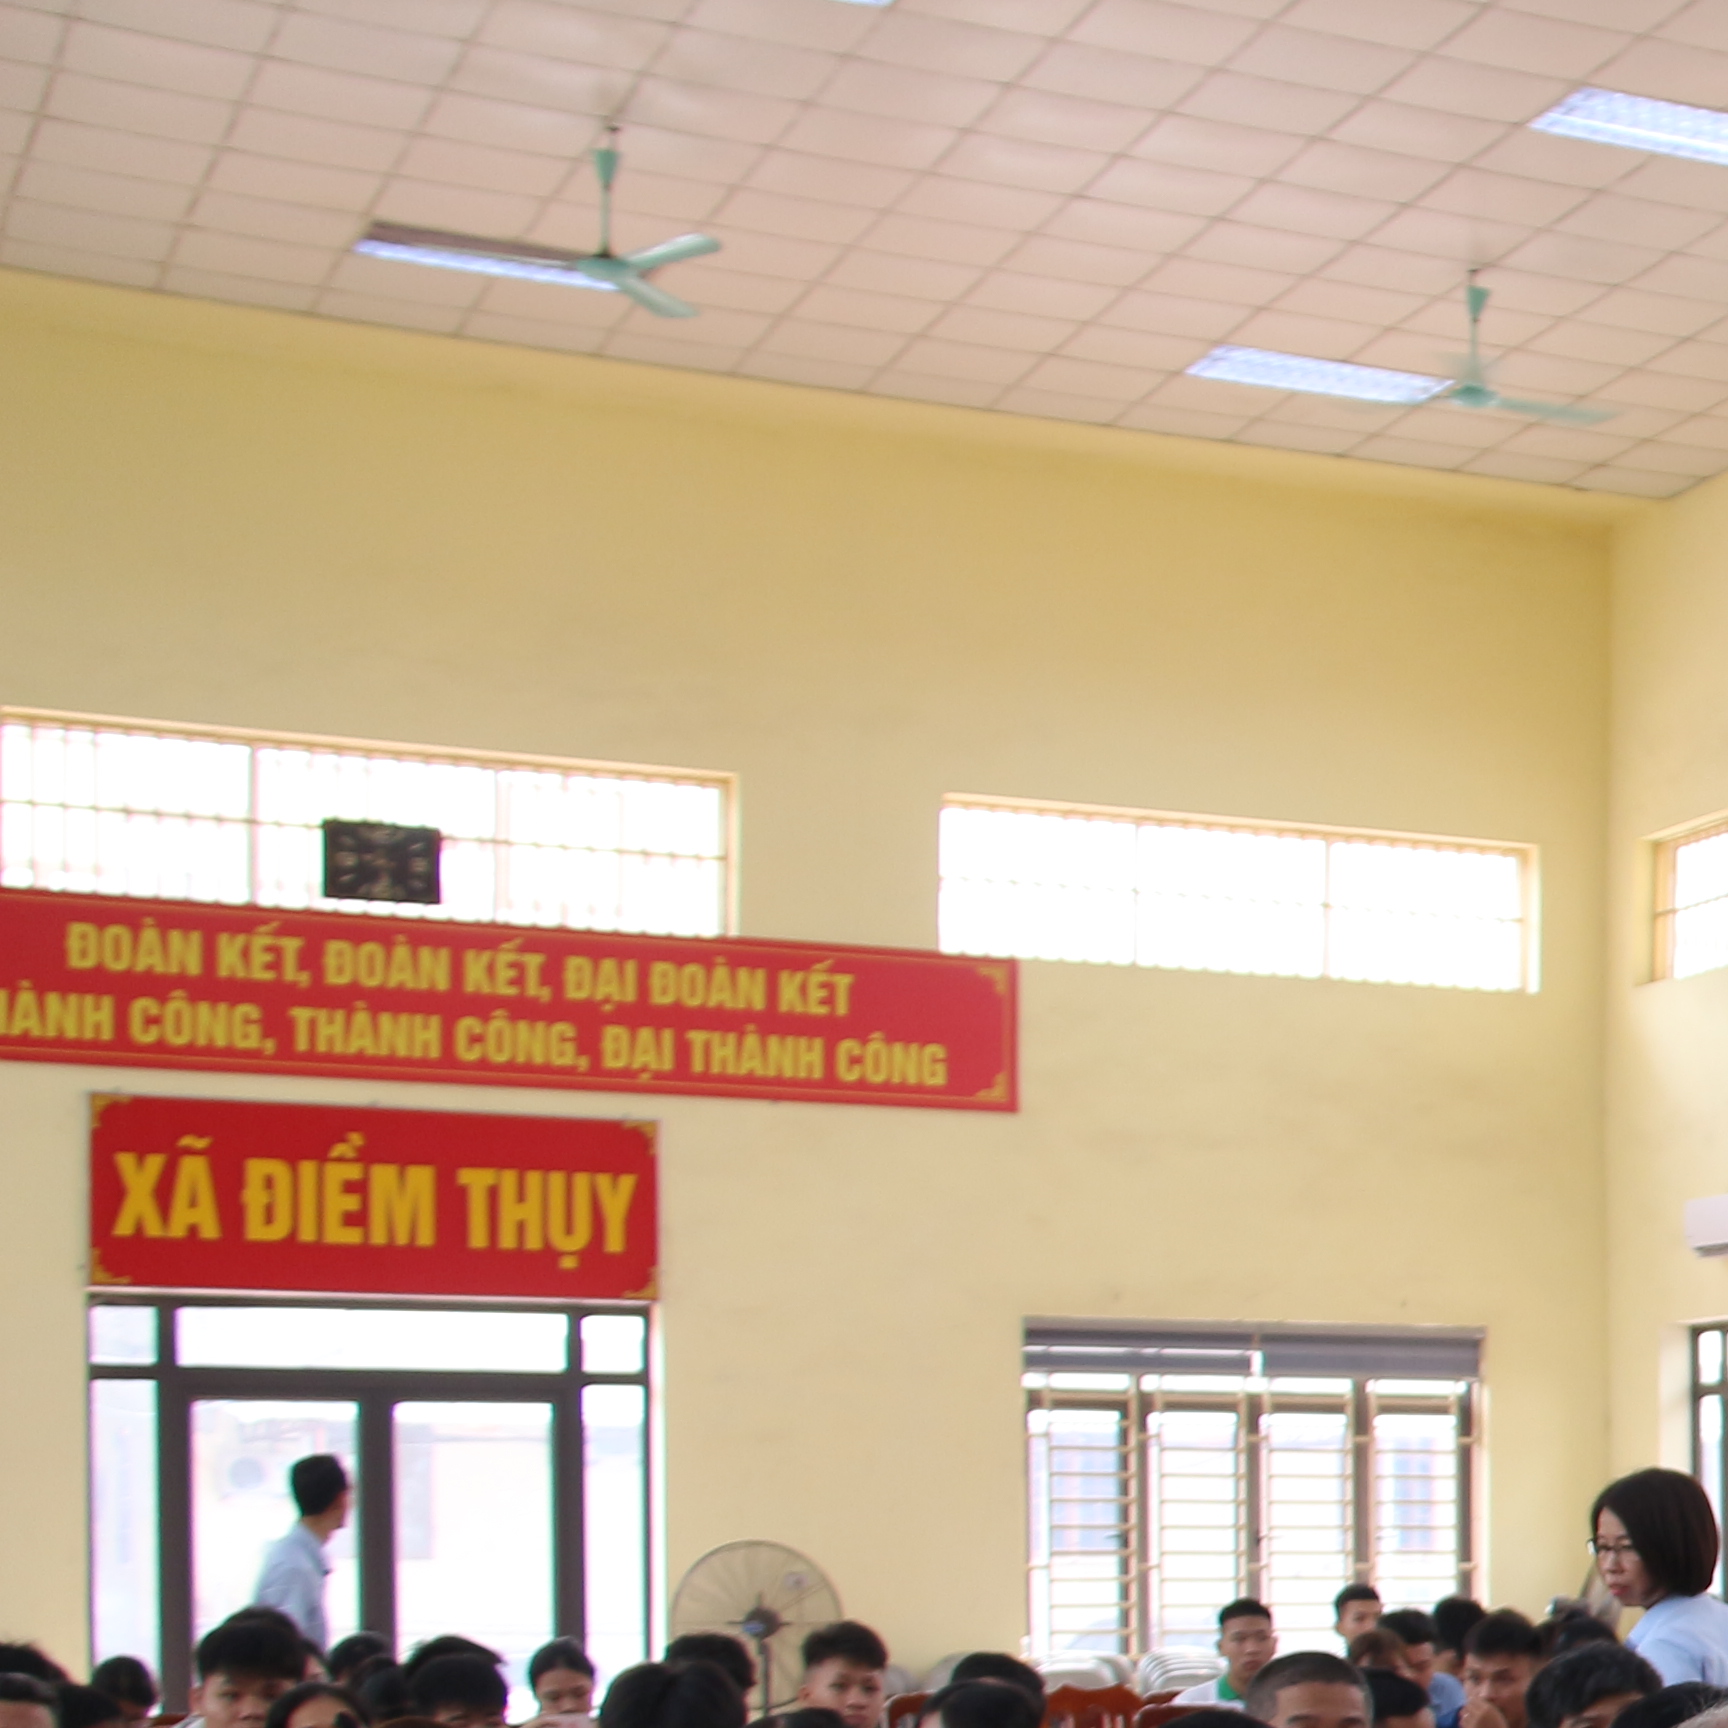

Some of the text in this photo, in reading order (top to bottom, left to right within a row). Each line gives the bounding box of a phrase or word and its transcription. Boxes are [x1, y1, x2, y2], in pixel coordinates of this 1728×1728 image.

[65, 917, 855, 1016] ĐOÀN KẾT, ĐOÀN KẾT, ĐẠI ĐOÀN KẾT
[0, 979, 949, 1087] ÀNH CÔNG, THÀNH CÔNG, ĐẠI THÀNH CÔNG
[111, 1131, 639, 1269] XÃ ĐIỂM THỤY
